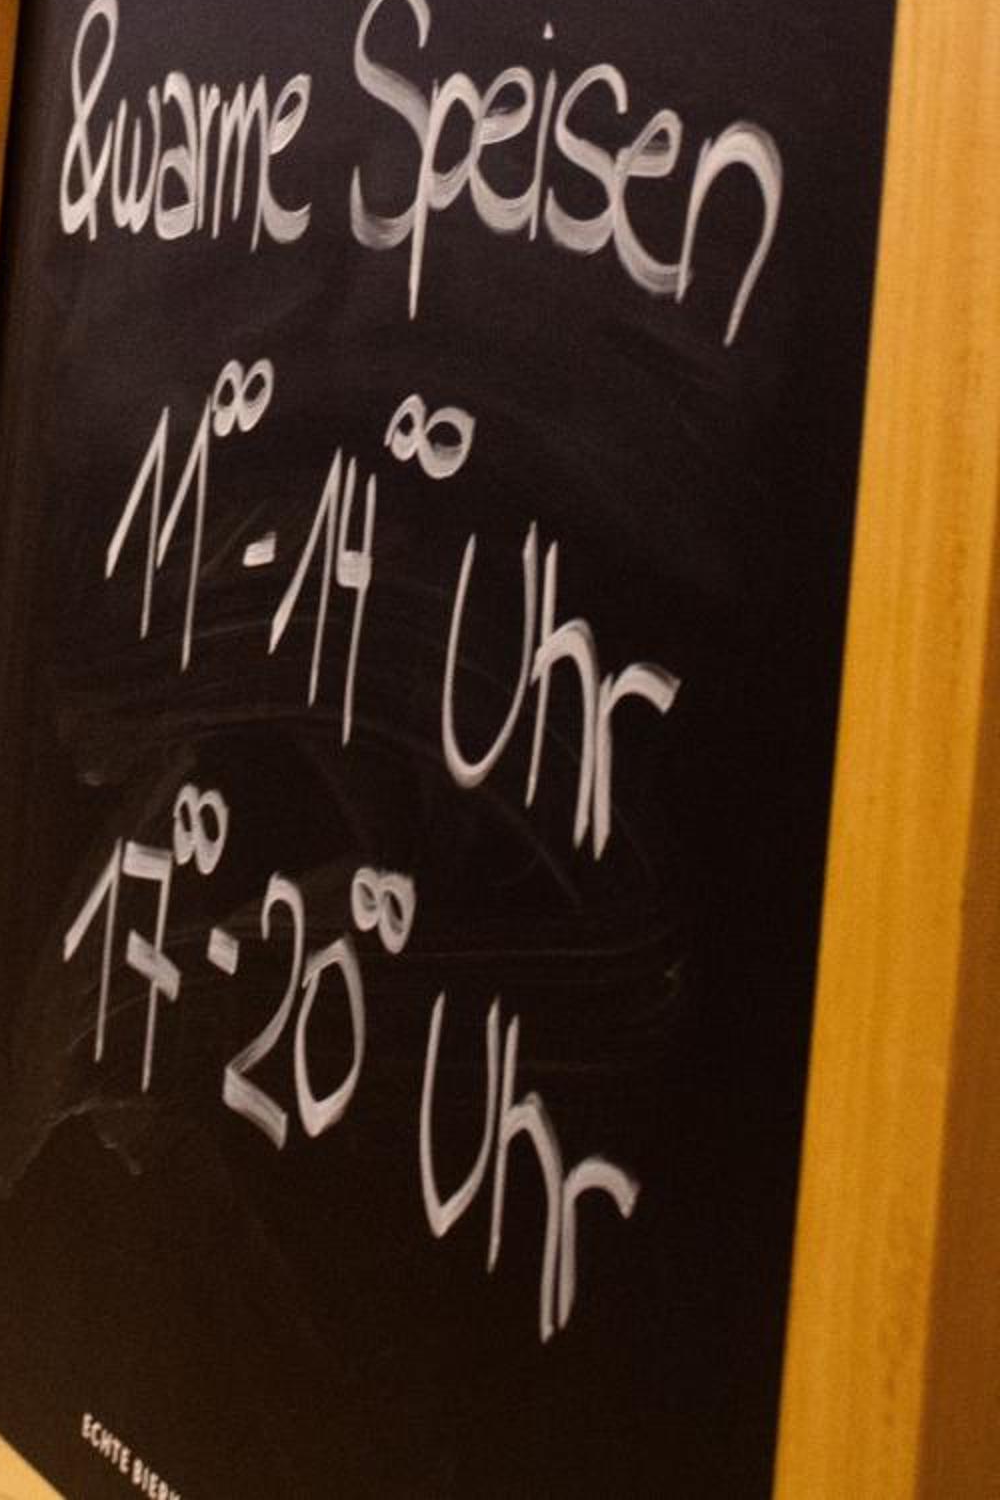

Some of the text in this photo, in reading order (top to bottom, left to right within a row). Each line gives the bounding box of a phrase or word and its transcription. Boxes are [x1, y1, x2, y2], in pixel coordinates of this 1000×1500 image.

[442, 520, 681, 861] Uhr
[419, 991, 641, 1344] Uhr
[81, 1412, 131, 1474] ECHTE
